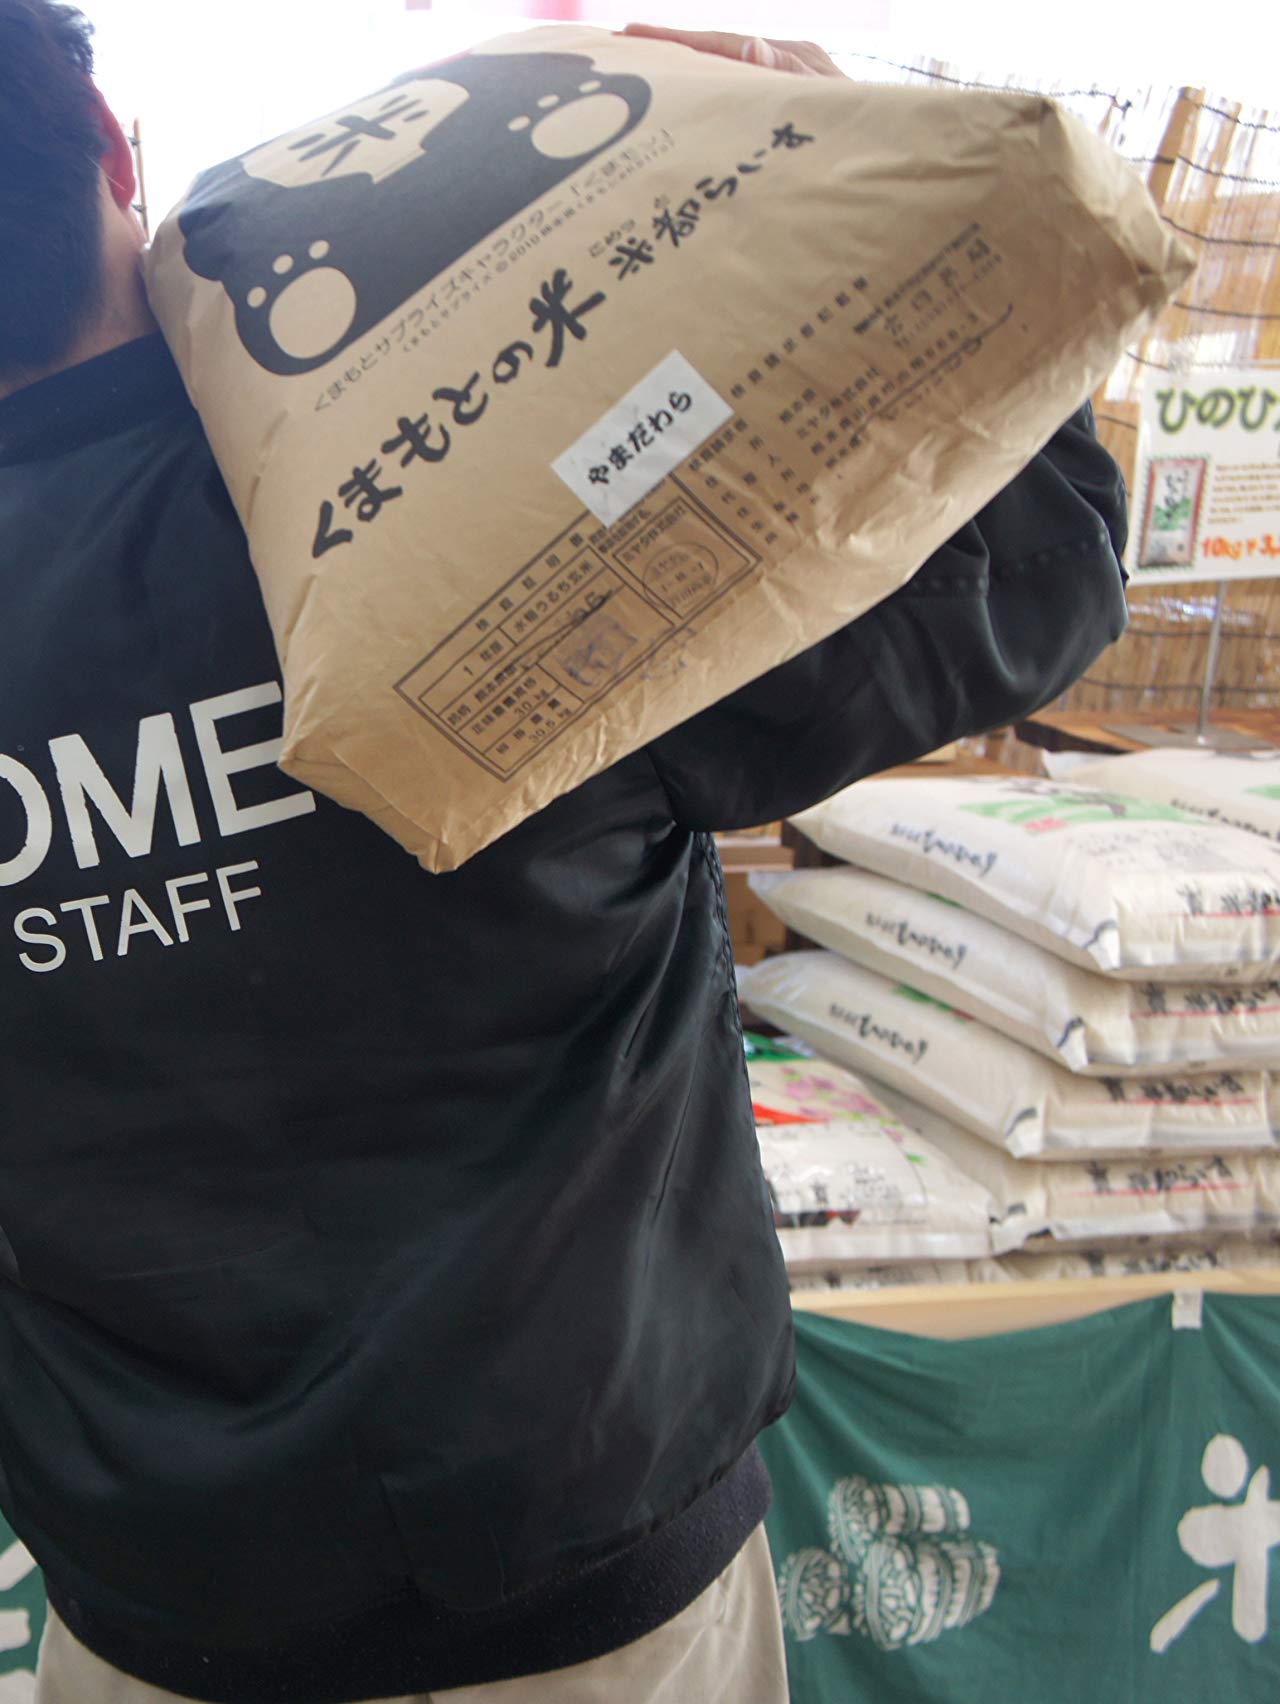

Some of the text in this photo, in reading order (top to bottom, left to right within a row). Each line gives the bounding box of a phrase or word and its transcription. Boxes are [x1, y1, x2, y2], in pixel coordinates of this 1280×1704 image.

[588, 391, 693, 486] やまだわら
[1155, 386, 1280, 434] ひのひ
[13, 860, 262, 973] STAFF
